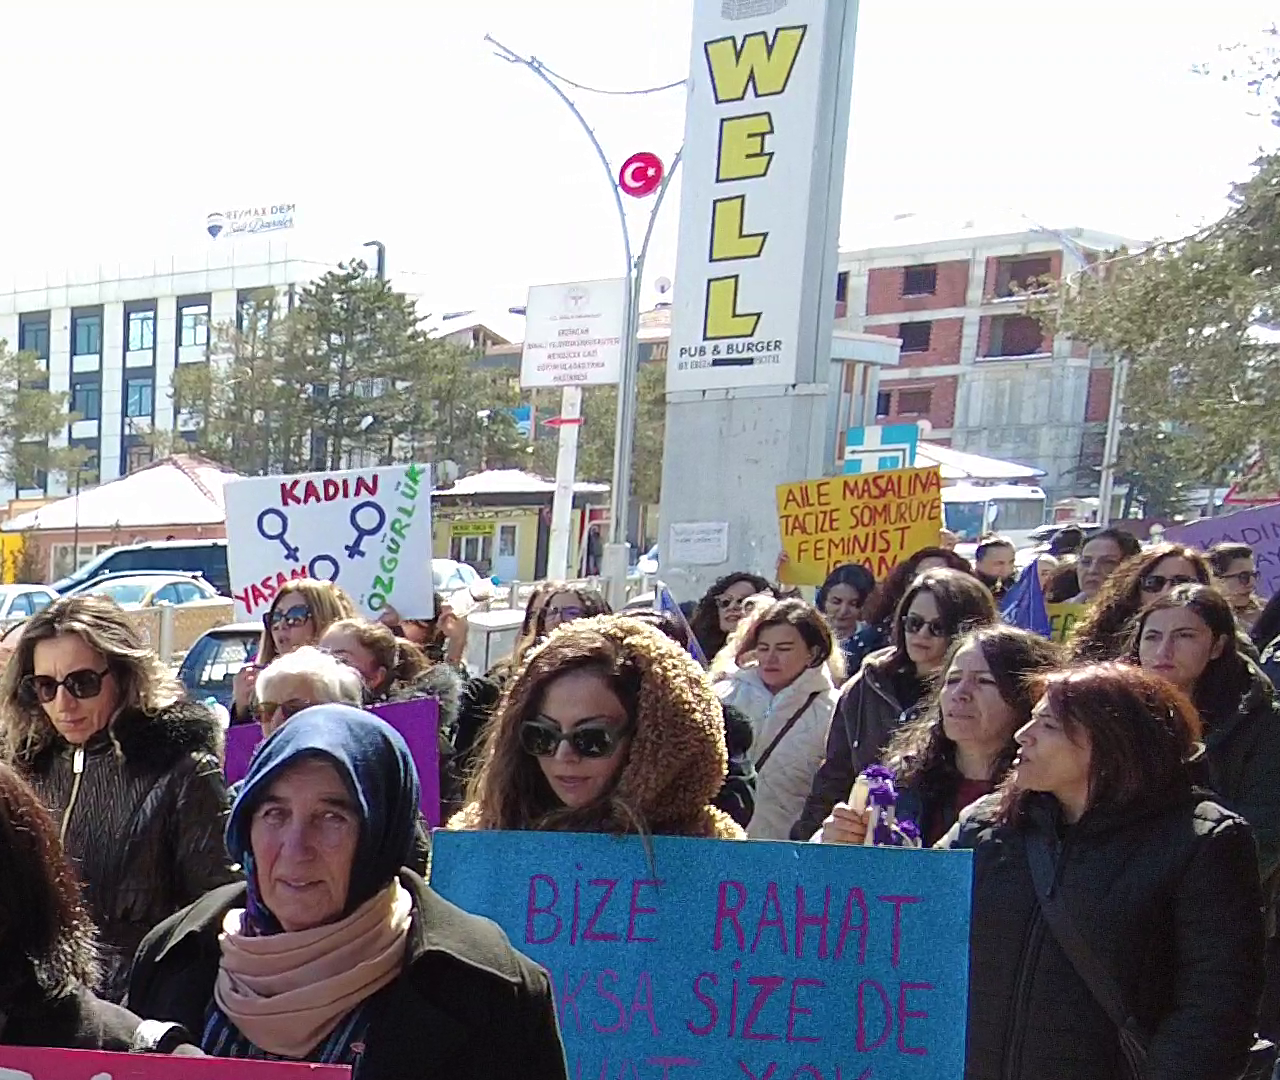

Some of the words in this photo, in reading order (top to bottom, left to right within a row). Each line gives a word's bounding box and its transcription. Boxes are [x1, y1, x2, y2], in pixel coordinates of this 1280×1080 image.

[703, 24, 807, 341] WELL
[679, 346, 707, 359] PUB
[711, 344, 721, 356] &
[726, 339, 782, 356] BURGER
[280, 474, 379, 507] KADIN
[524, 863, 667, 946] BİZE
[712, 880, 924, 969] RAHAT
[542, 964, 661, 1037] KSA
[686, 960, 825, 1043] SİZE
[854, 979, 936, 1056] DE
